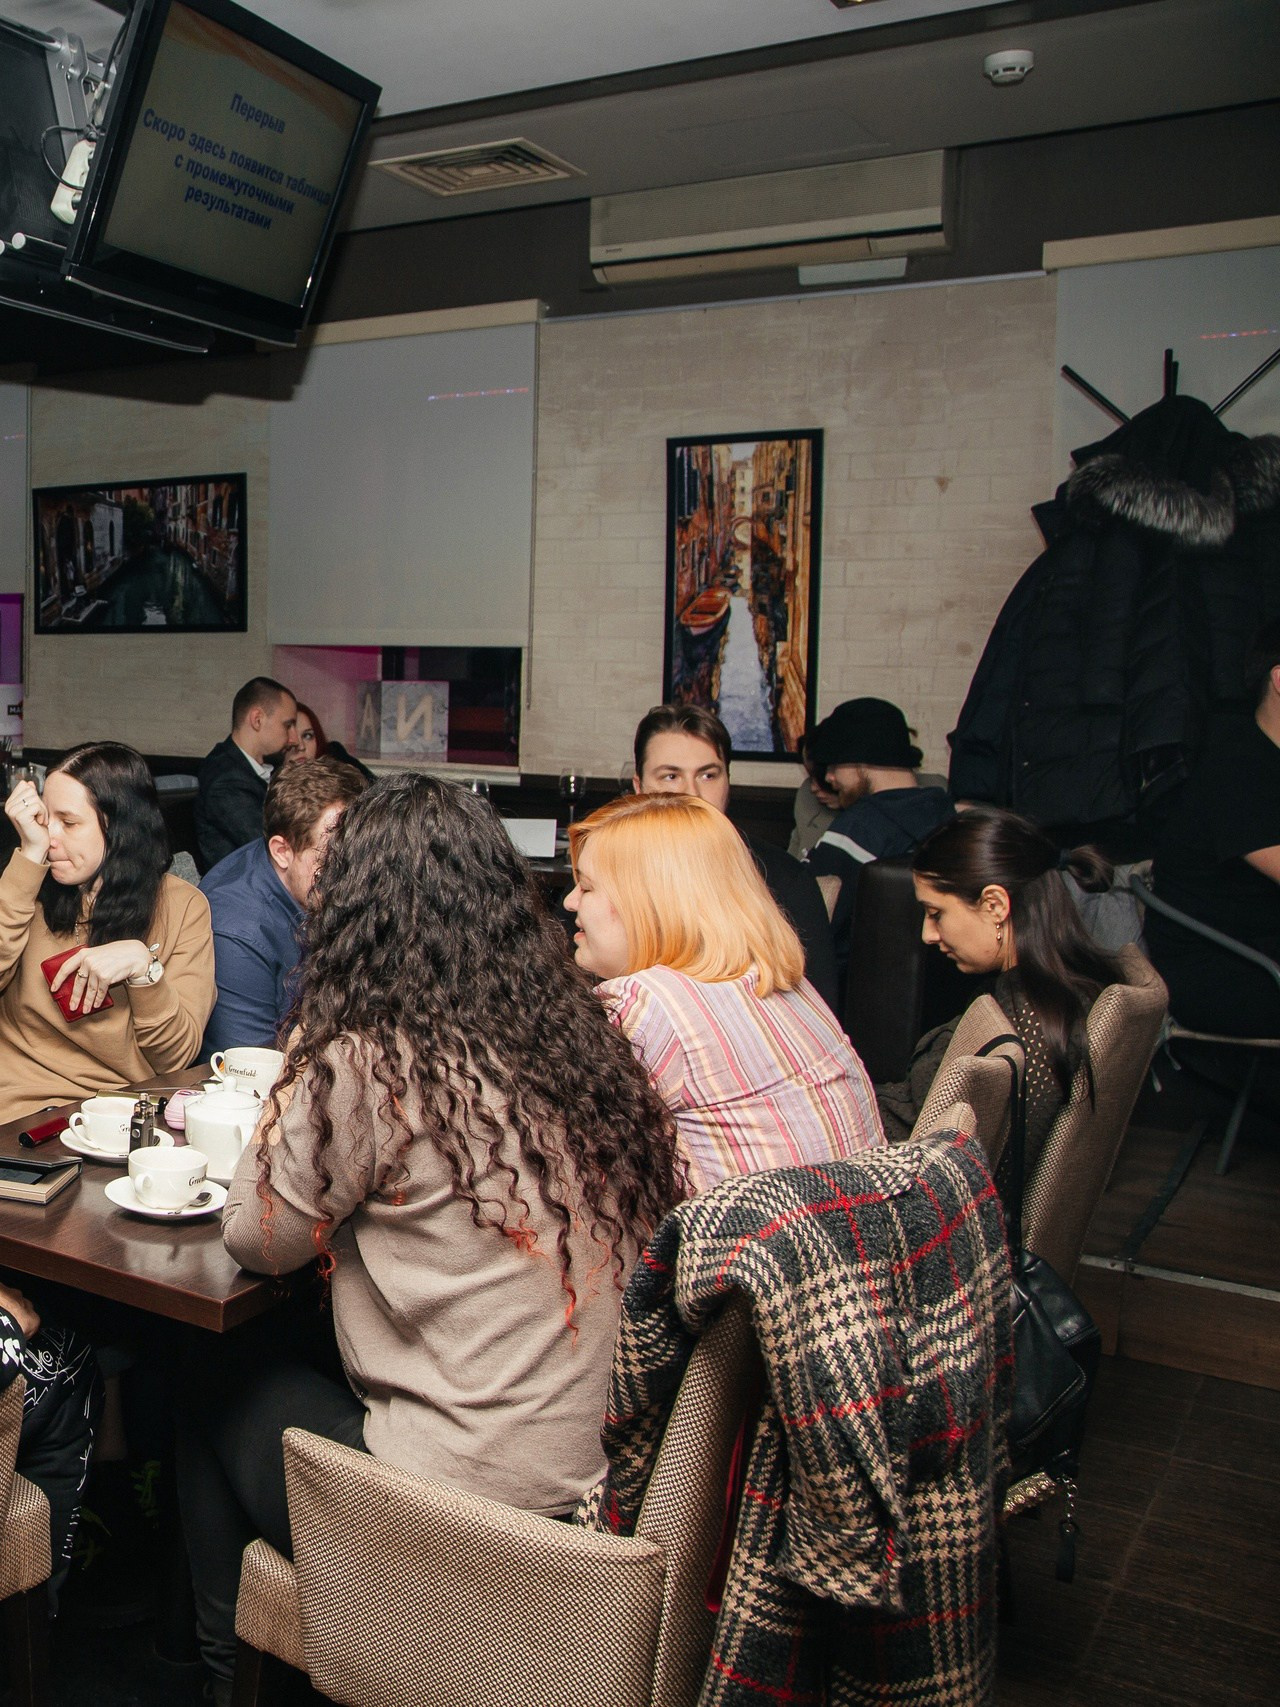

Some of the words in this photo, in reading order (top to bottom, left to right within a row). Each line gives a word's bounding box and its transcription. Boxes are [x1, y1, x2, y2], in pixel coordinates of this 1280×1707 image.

[230, 93, 285, 134] Перерыв
[143, 108, 185, 141] Скоро
[189, 132, 226, 160] здесь
[229, 149, 282, 184] появится
[175, 155, 183, 168] с
[186, 158, 294, 215] промежуточными
[185, 184, 271, 230] результатами
[228, 1064, 257, 1078] Greenfield
